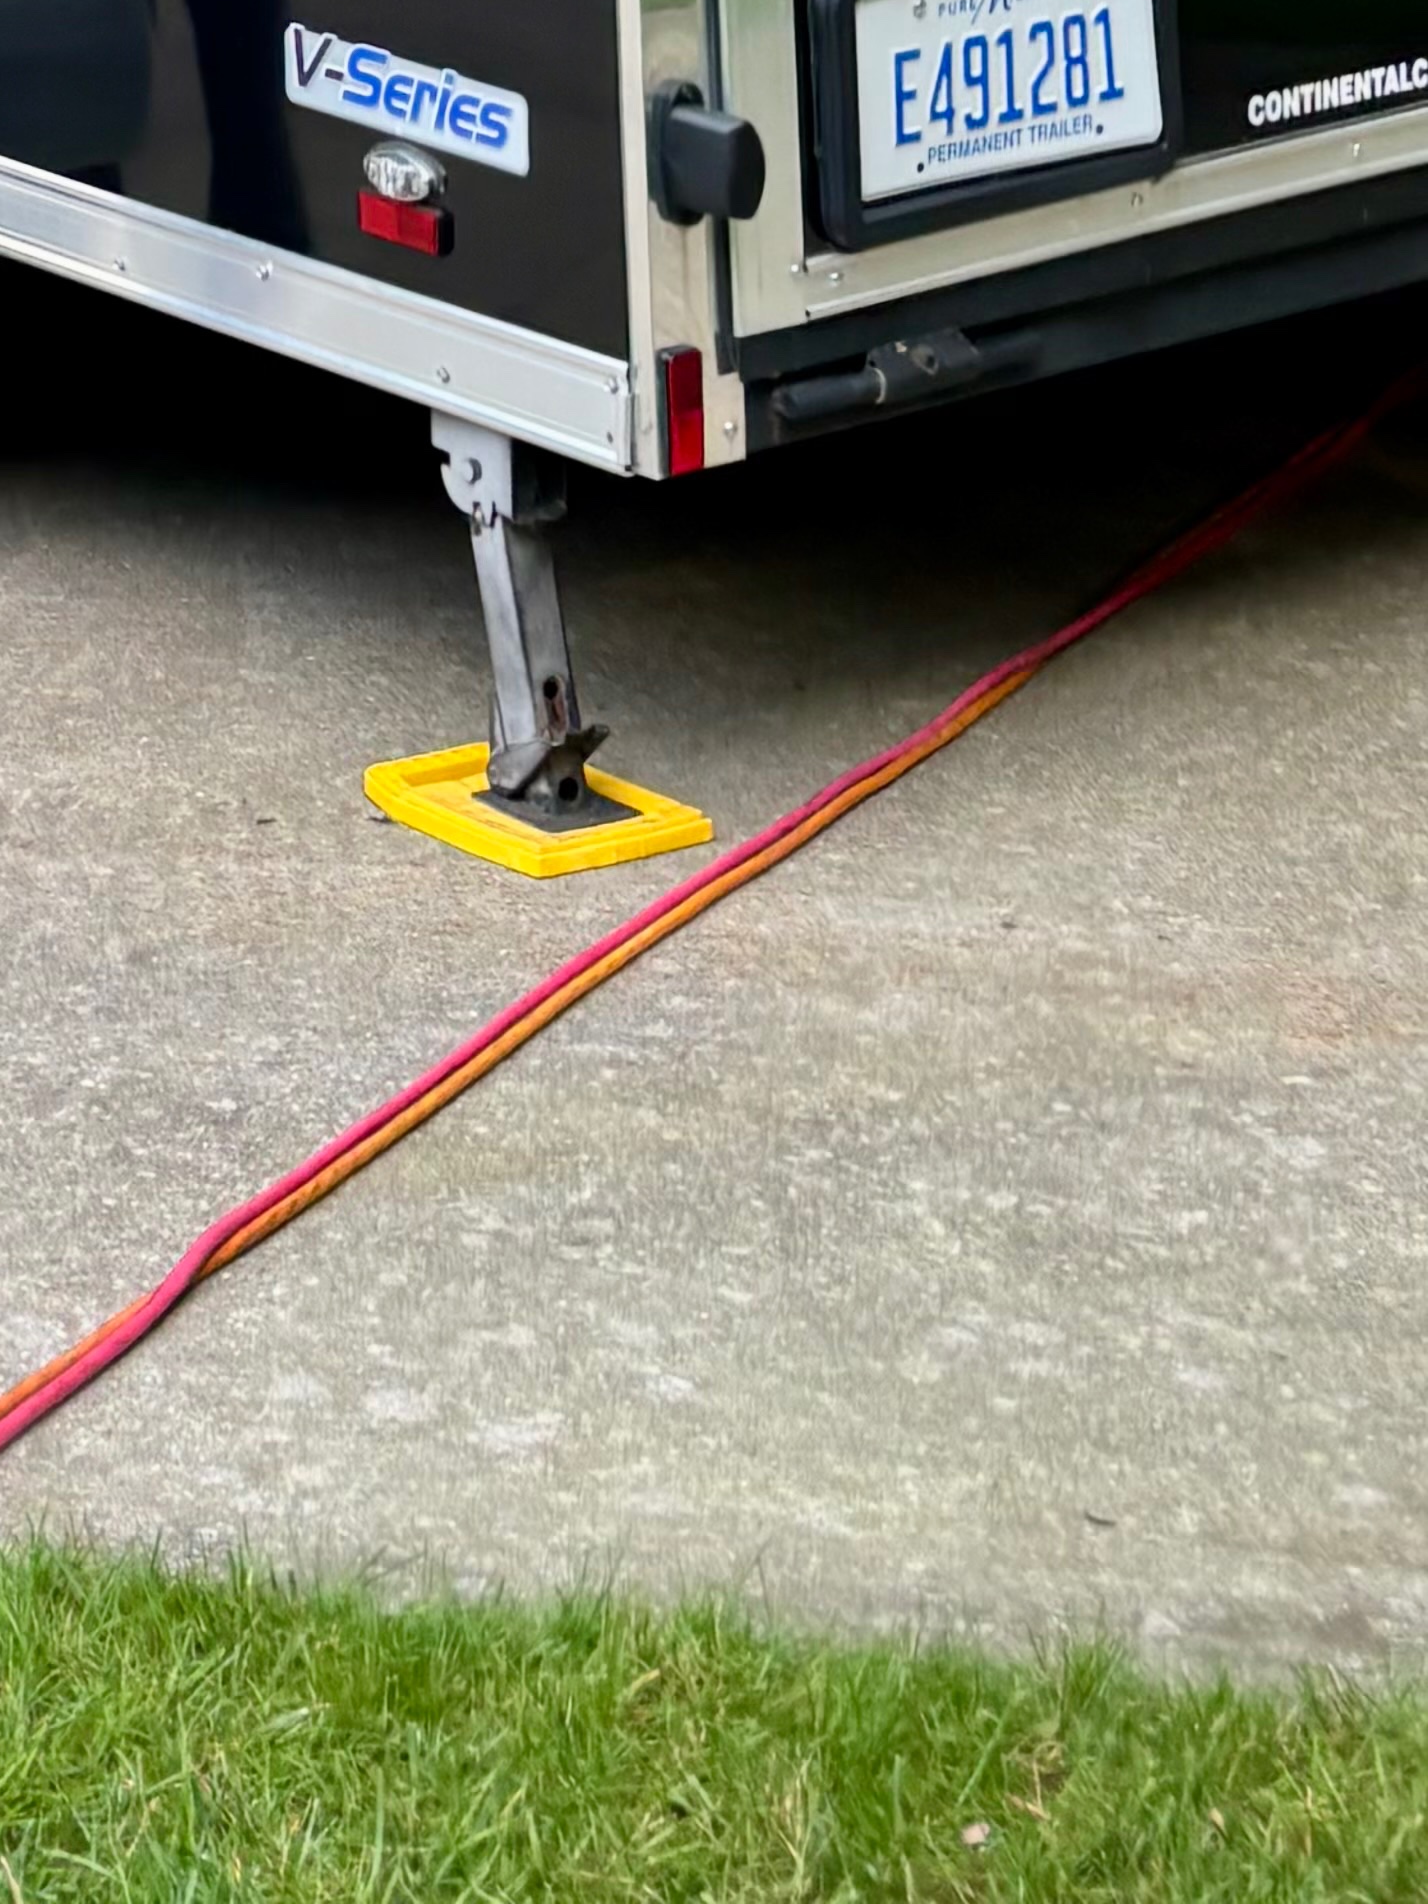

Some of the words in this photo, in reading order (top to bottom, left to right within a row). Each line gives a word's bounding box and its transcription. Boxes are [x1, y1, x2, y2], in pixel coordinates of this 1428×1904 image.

[293, 27, 513, 149] V-Series
[894, 5, 1125, 147] E491281
[926, 126, 1022, 166] PERMANENT
[1027, 113, 1094, 143] TRAILER
